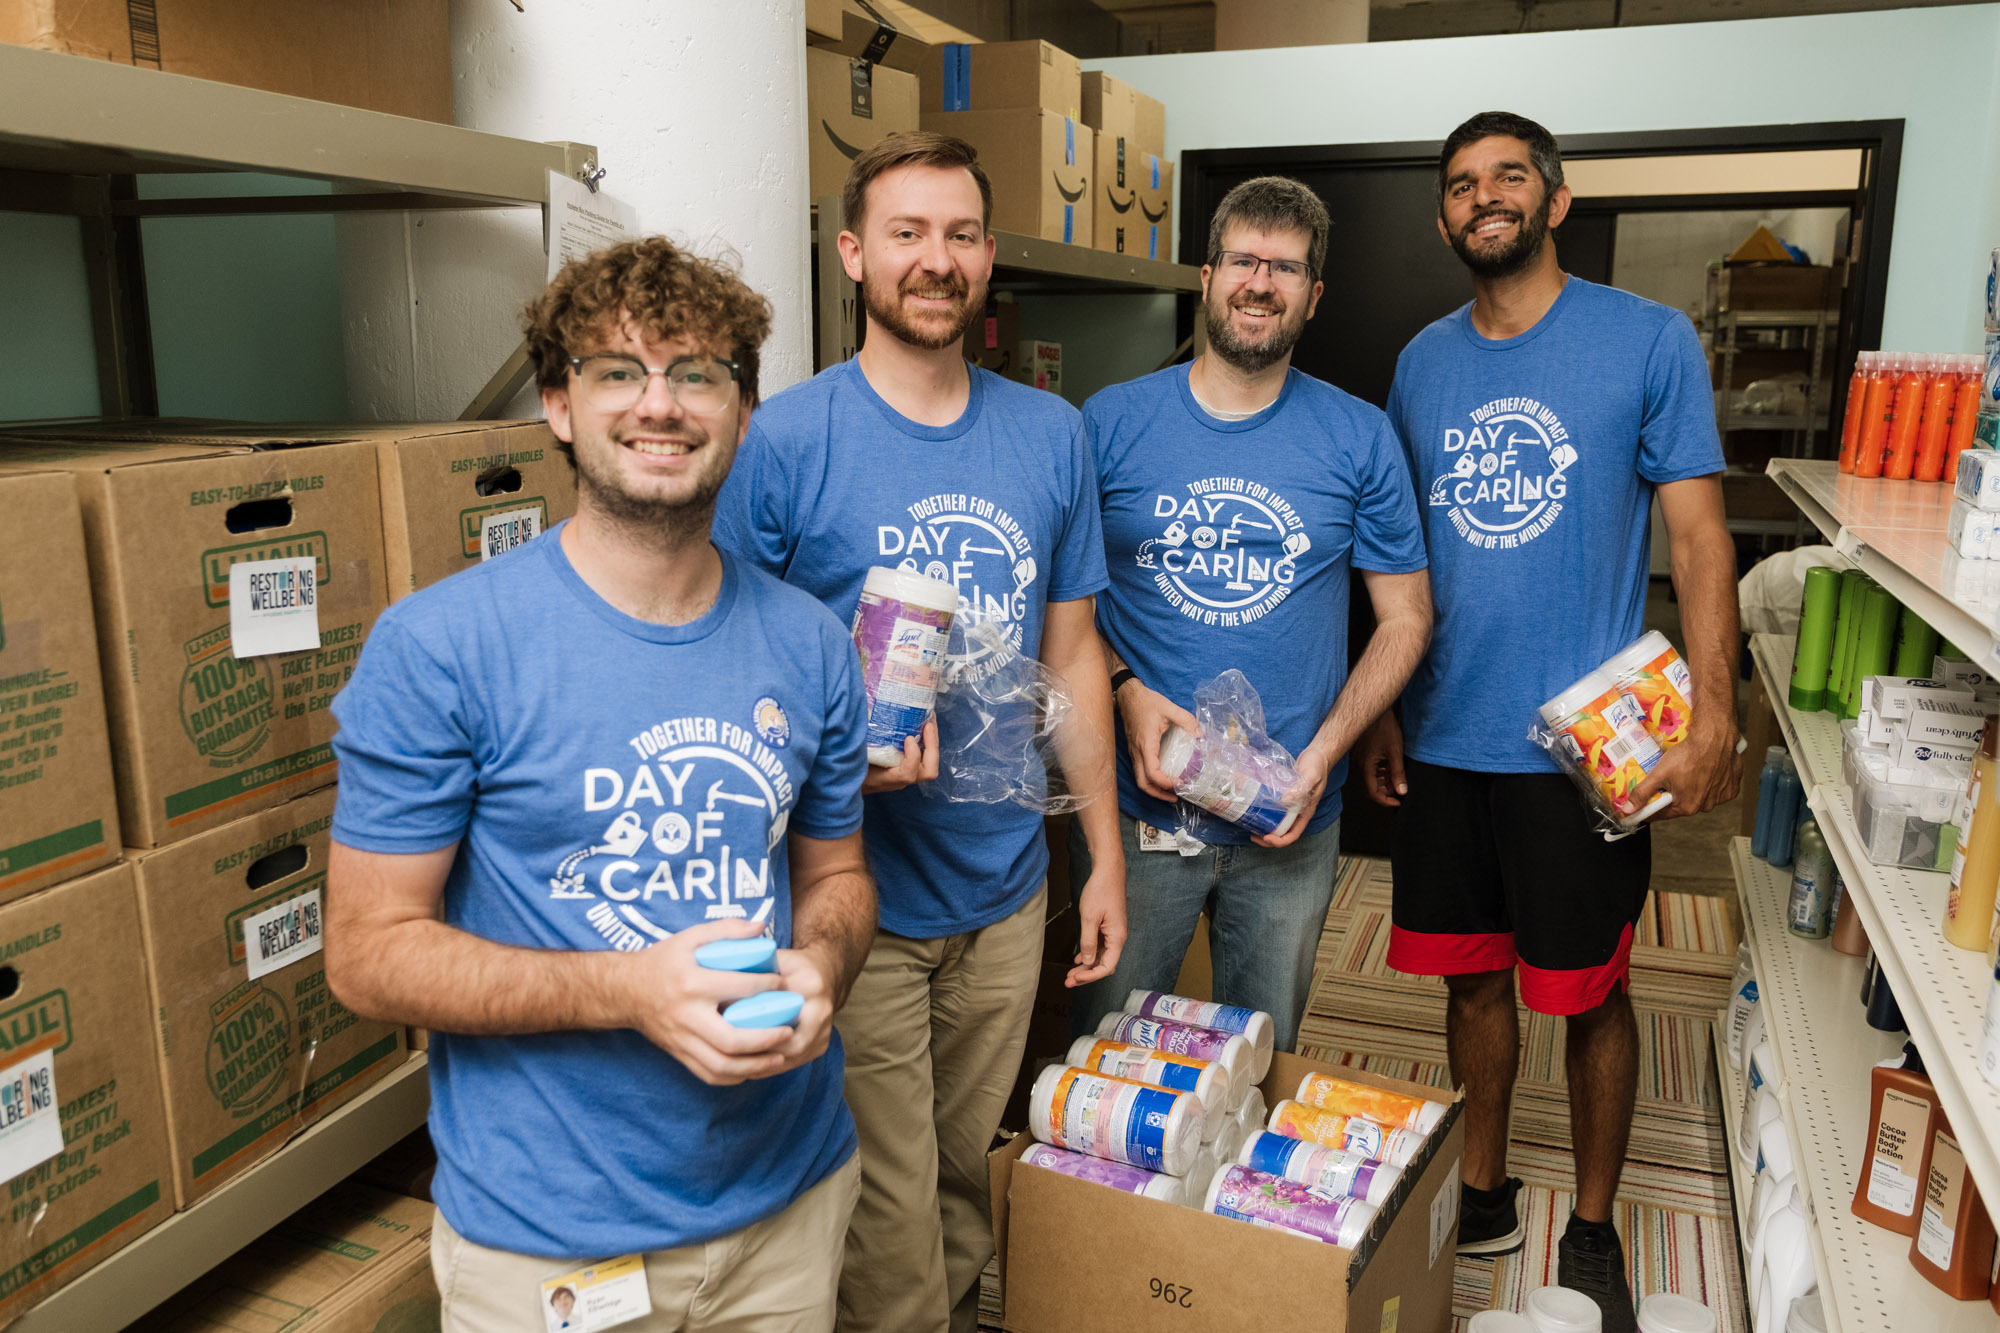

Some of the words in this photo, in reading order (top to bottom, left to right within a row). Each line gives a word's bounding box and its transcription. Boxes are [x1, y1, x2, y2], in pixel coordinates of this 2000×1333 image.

[1469, 397, 1519, 425] TOGETHER
[1518, 397, 1538, 416] FOR
[1537, 405, 1569, 444] IMPACT
[1444, 425, 1504, 452] DAY
[451, 453, 507, 473] EASY-TO-LIFT
[508, 449, 544, 465] HANDLES
[1479, 450, 1518, 476] OF
[190, 482, 272, 506] EASY-TO-LIFT
[1454, 470, 1567, 507] CARING
[1154, 495, 1225, 523] DAY
[1187, 477, 1244, 497] TOGETHER
[1245, 481, 1269, 500] FOR
[1266, 493, 1305, 532] IMPACT
[488, 517, 532, 542] RESTORING
[907, 494, 966, 523] TOGETHER
[969, 496, 993, 520] FOR
[992, 508, 1032, 554] IMPACT
[1192, 526, 1242, 551] OF
[1447, 506, 1471, 538] UNITED
[1467, 530, 1486, 548] WAY
[1485, 535, 1498, 549] OF
[1499, 535, 1518, 549] THE
[1518, 501, 1563, 545] MIDLANDS
[878, 526, 950, 556] DAY
[250, 568, 314, 592] RESTORING
[1162, 548, 1296, 588] CARING
[251, 588, 314, 611] WELLBEING
[957, 585, 1026, 626] RING
[1154, 572, 1181, 607] UNITED
[1180, 601, 1204, 622] WAY
[1204, 610, 1219, 626] OF
[1220, 612, 1239, 627] THE
[1240, 585, 1291, 625] MIDLANDS
[189, 627, 231, 656] U-HAU
[898, 628, 925, 646] Lysol
[281, 656, 312, 679] TAKE
[316, 643, 363, 670] PLENTY!
[190, 652, 257, 704] 100%
[283, 675, 313, 699] We'll
[317, 670, 340, 689] Buy
[191, 678, 270, 735] BUY-BACK
[285, 702, 306, 720] the
[309, 694, 335, 714] Extr
[1926, 726, 1950, 735] clean
[241, 748, 332, 788] uhaul.com
[630, 717, 717, 761] TOGETHER
[721, 722, 754, 756] FOR
[752, 742, 793, 807] IMPACT
[1933, 750, 1953, 762] fully
[1954, 752, 1973, 762] clea
[585, 763, 695, 812] DAY
[652, 811, 725, 855] OF
[214, 832, 289, 875] EASY-TO-LIFT
[601, 845, 770, 910] CARIN
[259, 901, 318, 942] RESTORING
[260, 919, 319, 960] WELLBEING
[295, 969, 325, 998] NEED
[297, 989, 326, 1016] TAKE
[214, 998, 274, 1060] 100%
[215, 1021, 287, 1091] BUY-BACK
[62, 1101, 119, 1147] LENTY!
[1879, 1129, 1907, 1145] Butter
[1881, 1122, 1906, 1137] Cocoa
[56, 1142, 88, 1175] Buy
[93, 1118, 131, 1153] Back
[1876, 1145, 1904, 1161] Lotion
[1878, 1137, 1900, 1151] Body
[45, 1162, 102, 1204] Extras.
[1929, 1174, 1948, 1192] Butter
[1931, 1165, 1948, 1183] Cocoa
[1927, 1190, 1945, 1209] Lotion
[1928, 1183, 1942, 1198] Body
[1149, 1276, 1194, 1309] 296
